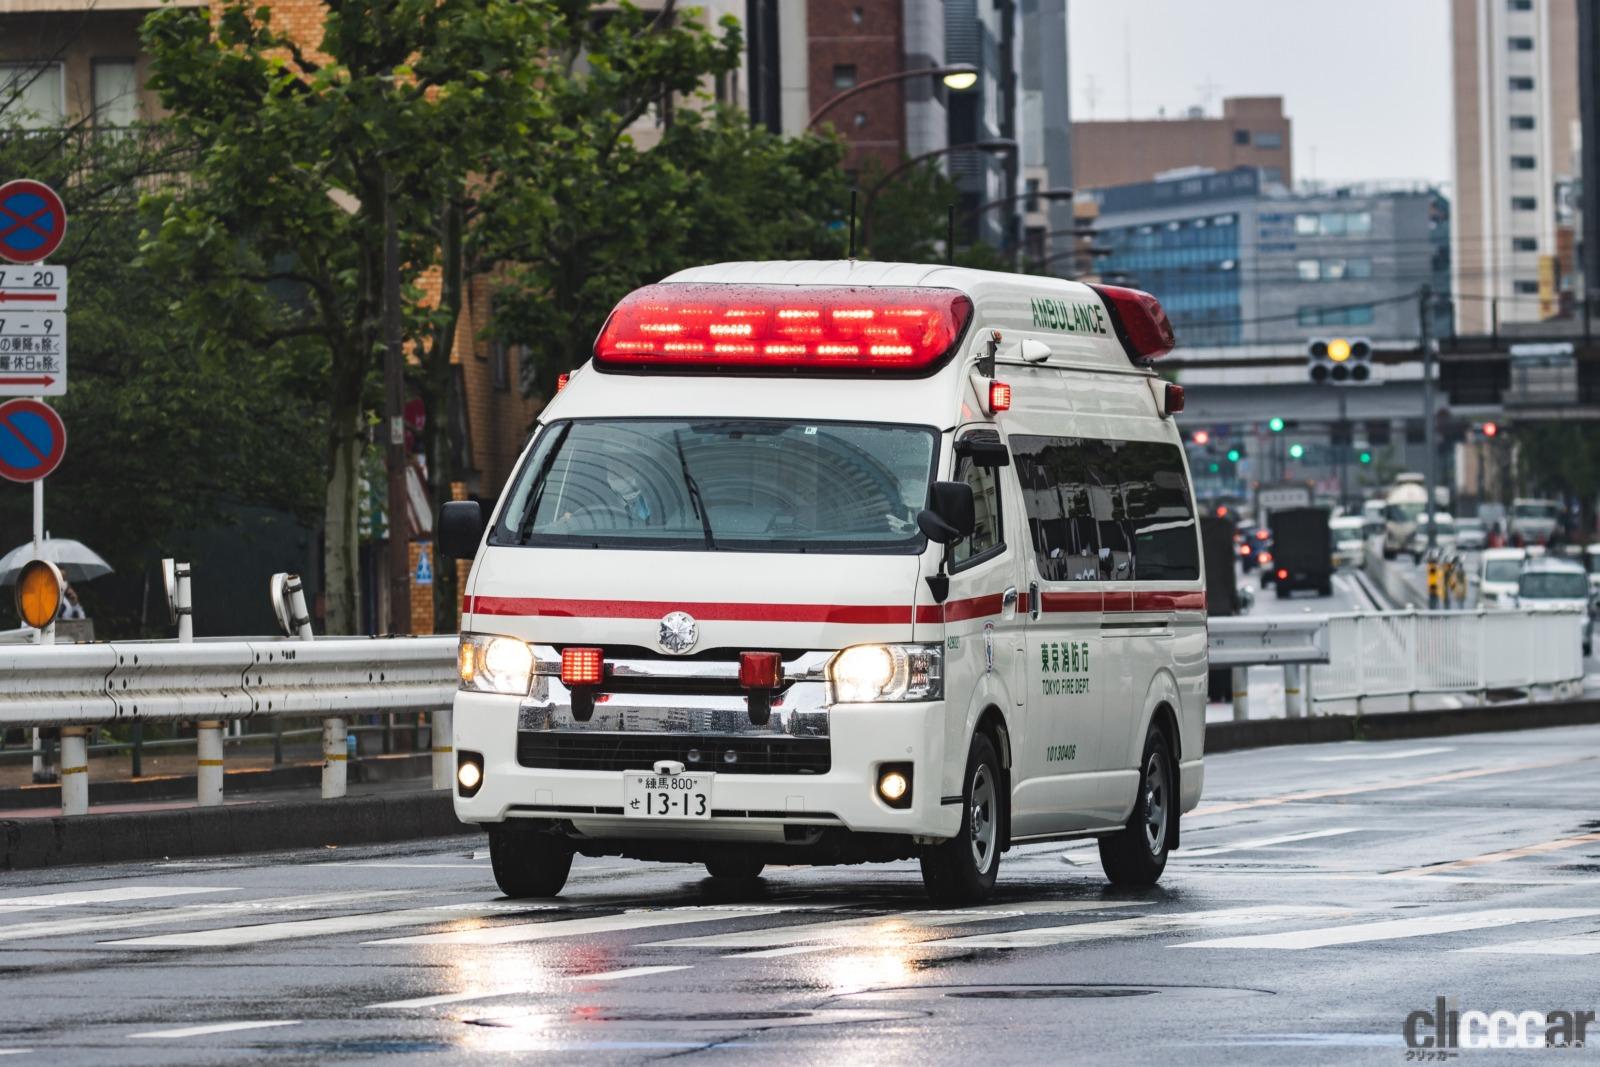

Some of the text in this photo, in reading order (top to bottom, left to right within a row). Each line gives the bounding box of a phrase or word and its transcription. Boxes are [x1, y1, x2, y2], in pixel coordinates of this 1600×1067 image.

[33, 271, 54, 287] 20
[1031, 298, 1106, 334] AMBULANCE
[43, 318, 53, 334] 9
[1040, 642, 1089, 673] 東京消防庁
[1042, 679, 1061, 696] TOKYO
[1061, 678, 1074, 695] FIRE
[1046, 744, 1077, 762] 10130406
[645, 777, 693, 790] 練馬 800
[629, 792, 706, 816] せ 13-13
